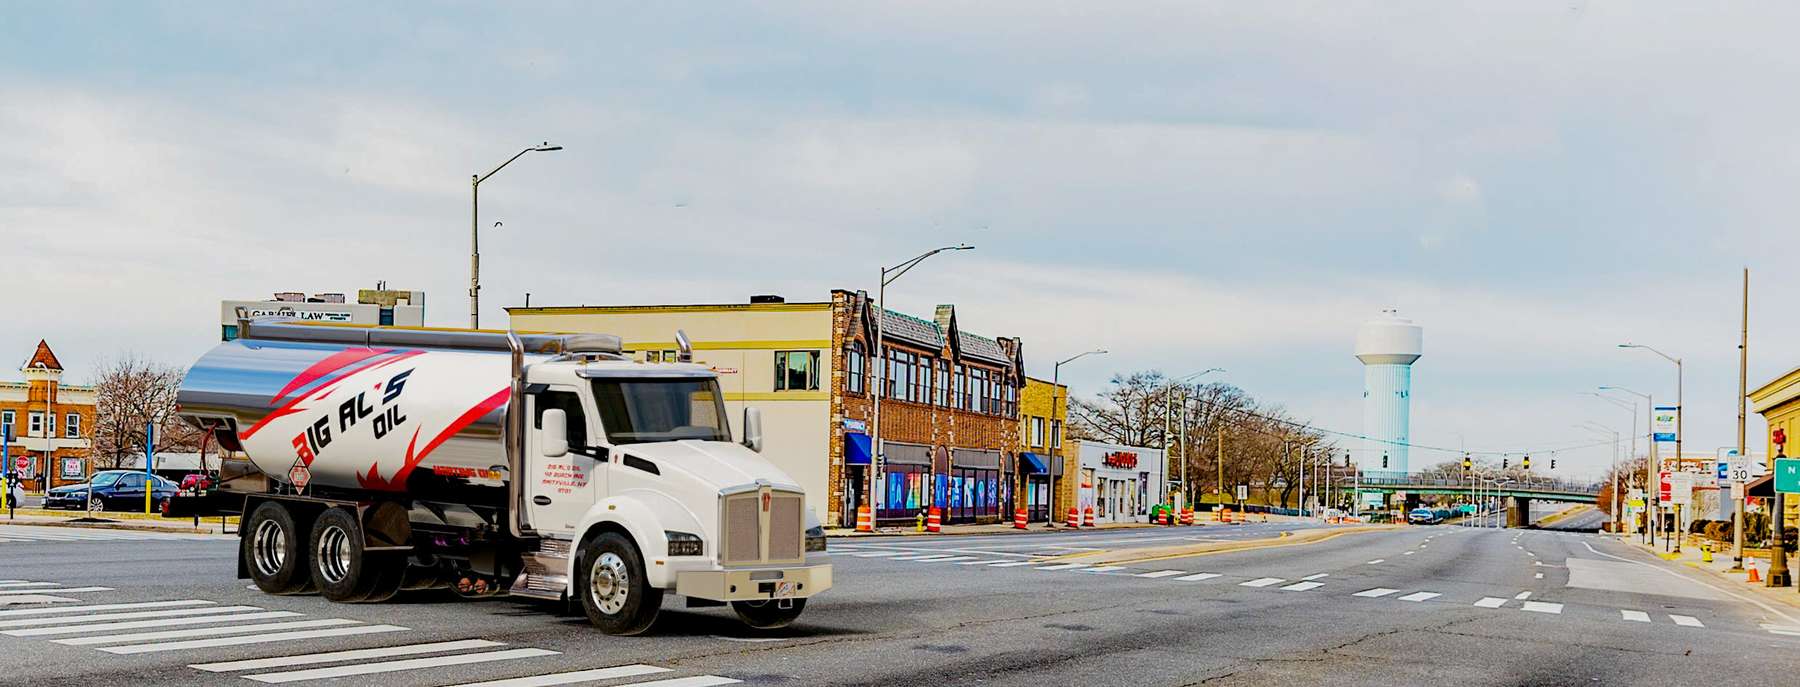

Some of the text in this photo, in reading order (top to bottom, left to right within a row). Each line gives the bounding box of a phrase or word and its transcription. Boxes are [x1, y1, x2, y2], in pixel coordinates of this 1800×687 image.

[301, 312, 323, 320] LAW
[292, 367, 416, 467] BIG AL'S
[373, 404, 407, 440] OIL
[1732, 470, 1748, 480] 30
